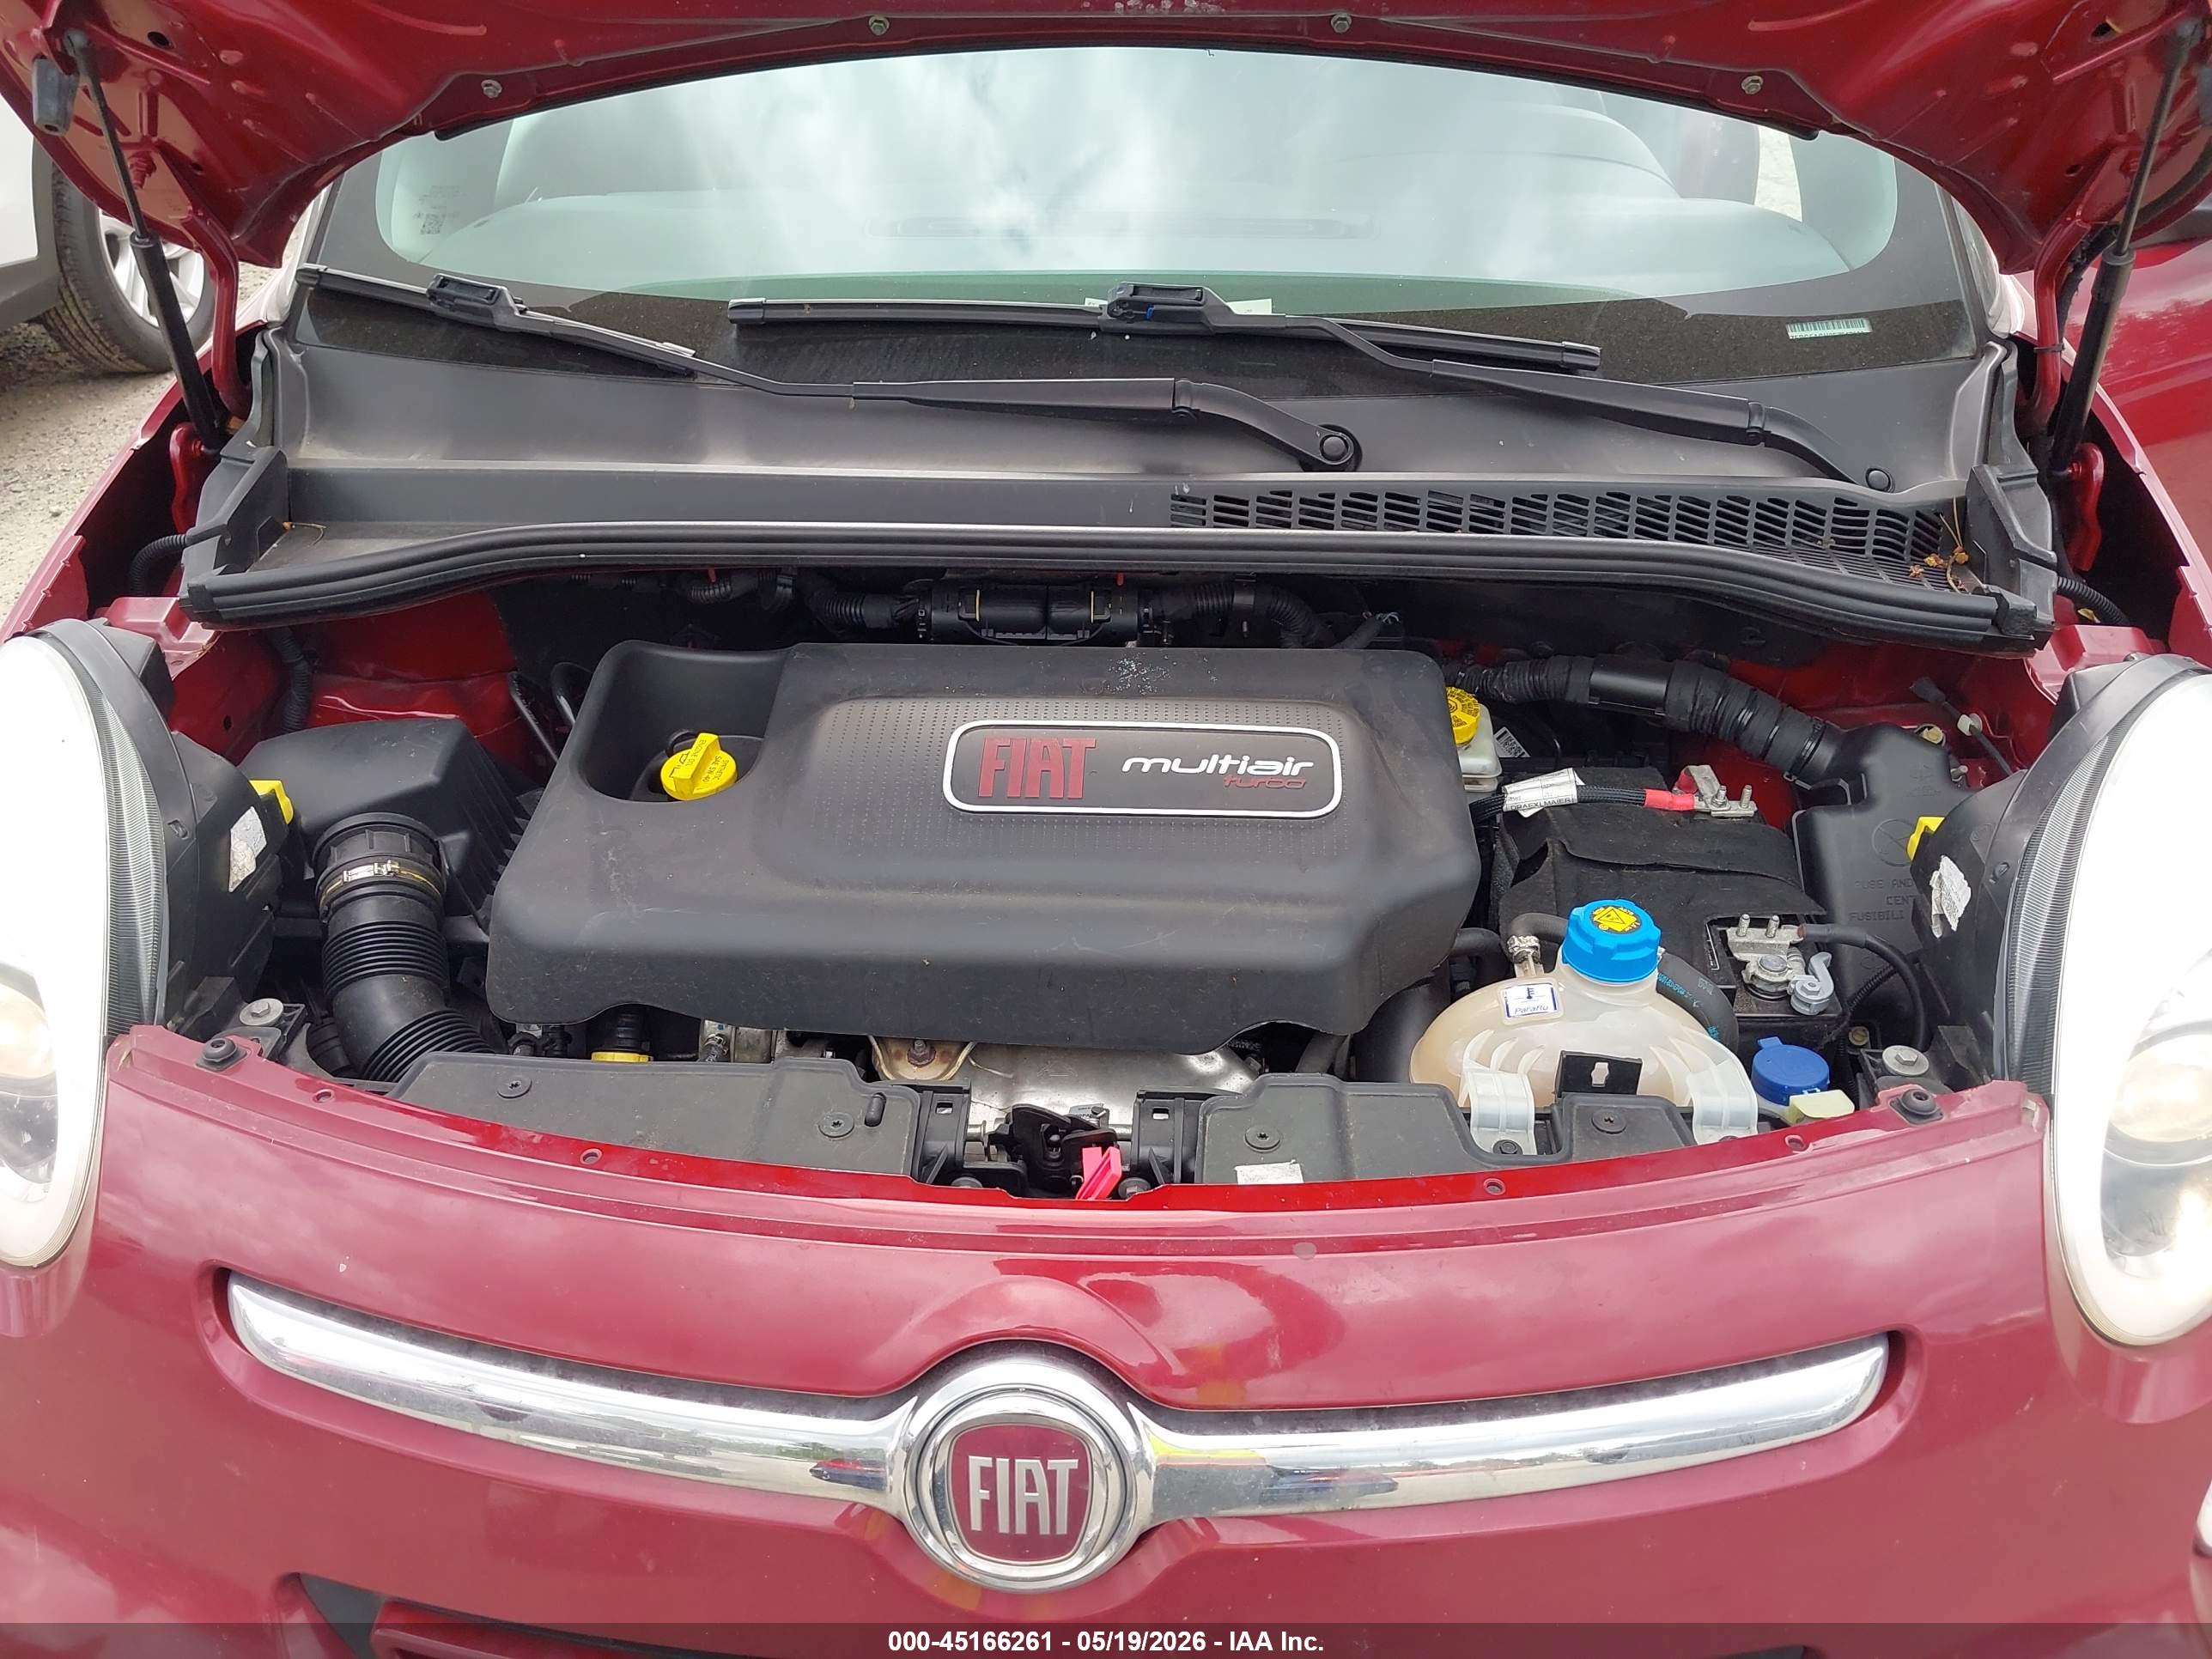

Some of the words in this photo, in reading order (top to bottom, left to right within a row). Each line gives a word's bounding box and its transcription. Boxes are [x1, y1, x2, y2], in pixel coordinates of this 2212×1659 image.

[977, 737, 1097, 799] FIAT
[1121, 754, 1314, 776] multiair
[1224, 775, 1307, 789] turbo
[969, 1455, 1079, 1534] FIAT
